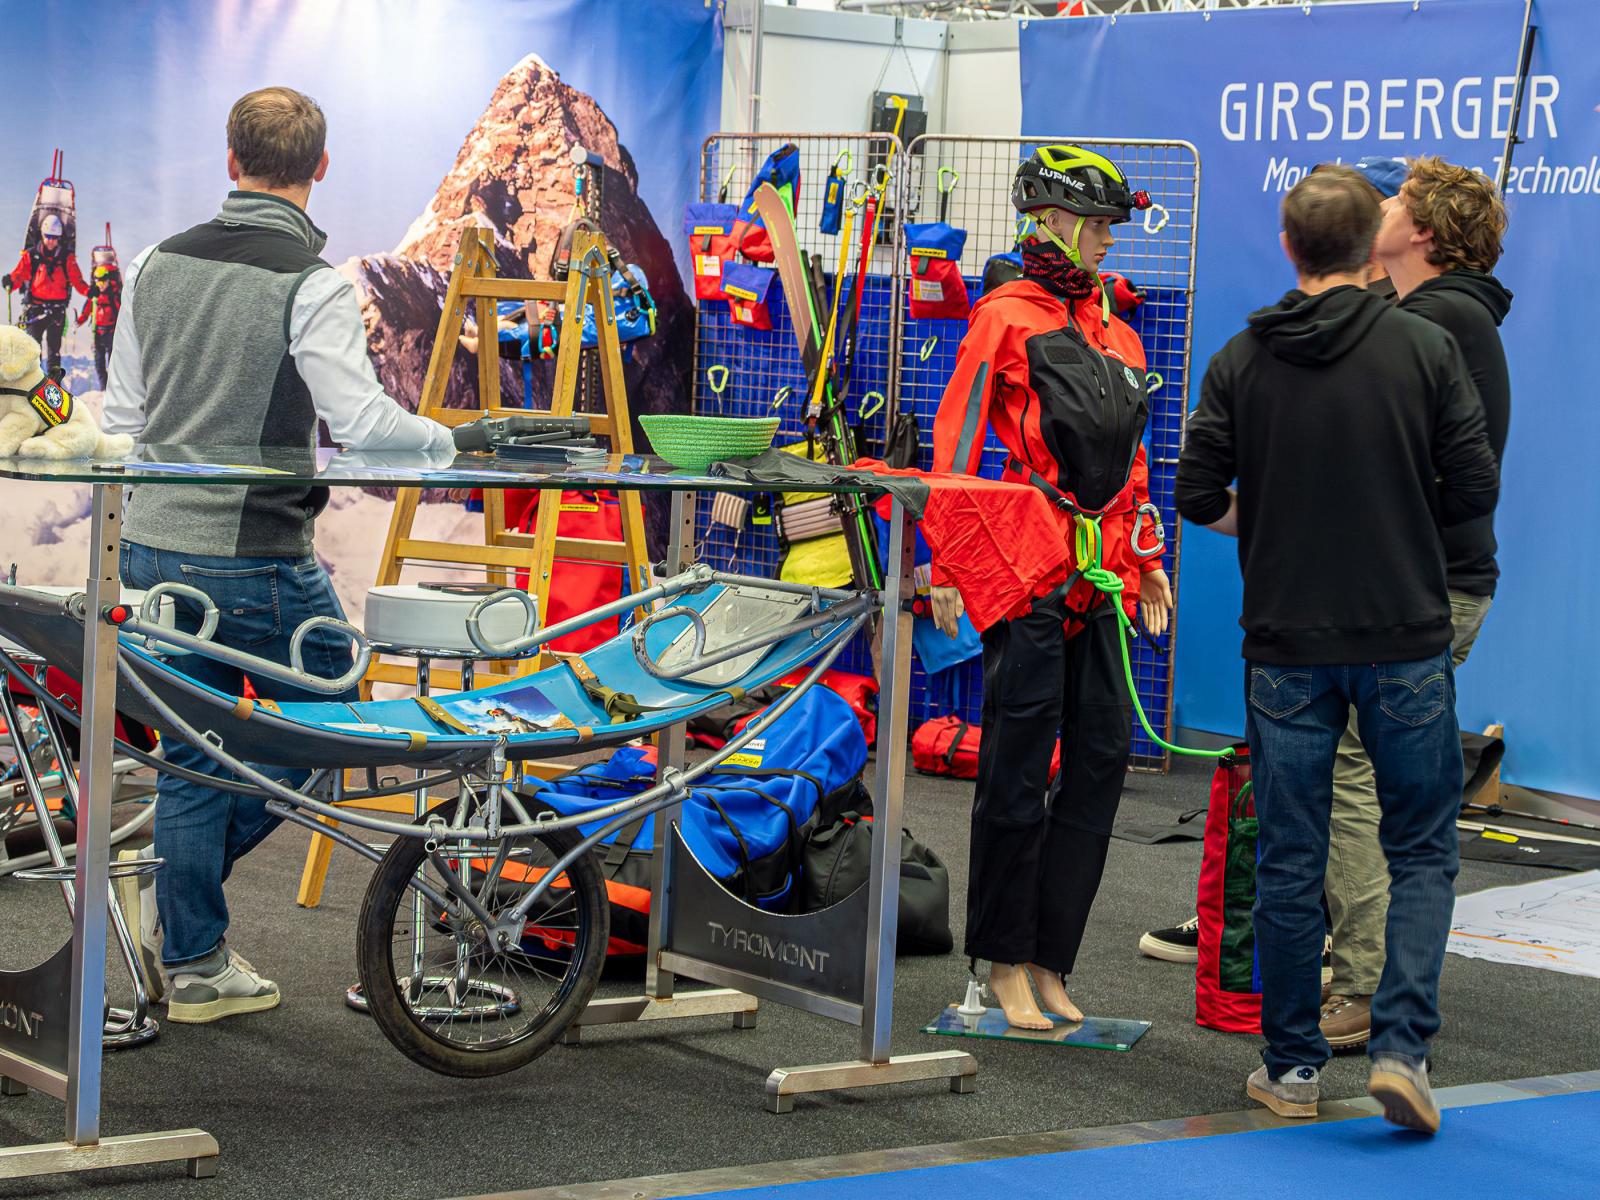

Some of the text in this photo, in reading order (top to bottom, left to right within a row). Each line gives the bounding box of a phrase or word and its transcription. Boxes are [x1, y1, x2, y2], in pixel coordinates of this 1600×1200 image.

[1219, 75, 1561, 142] GIRSBERGER
[1038, 167, 1086, 191] LUPINE
[708, 921, 830, 973] TYROMONT
[0, 1000, 44, 1039] ONT
